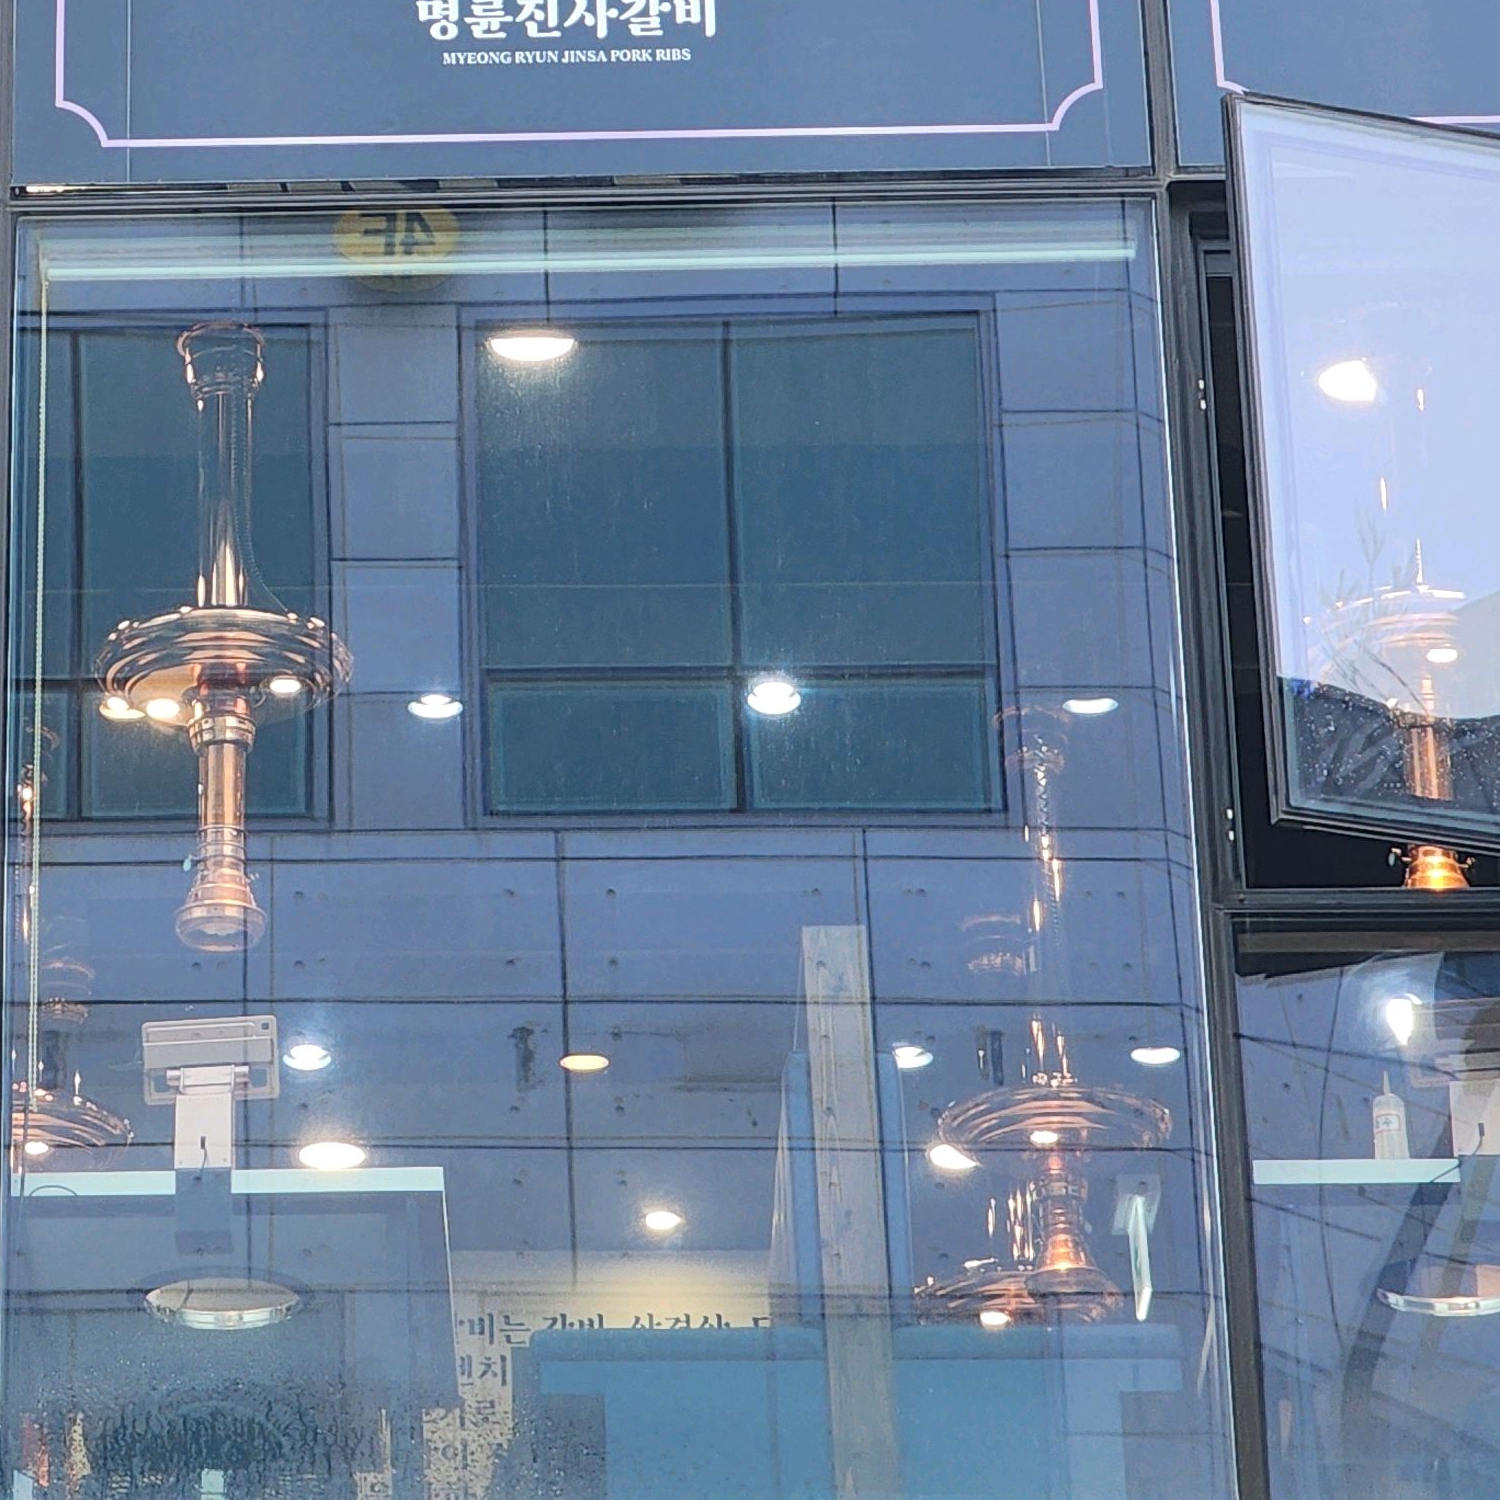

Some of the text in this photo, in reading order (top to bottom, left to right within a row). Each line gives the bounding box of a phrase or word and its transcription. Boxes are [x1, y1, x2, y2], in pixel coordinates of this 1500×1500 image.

[443, 47, 691, 66] MYEONG RYUN JINSA PORK RIBS
